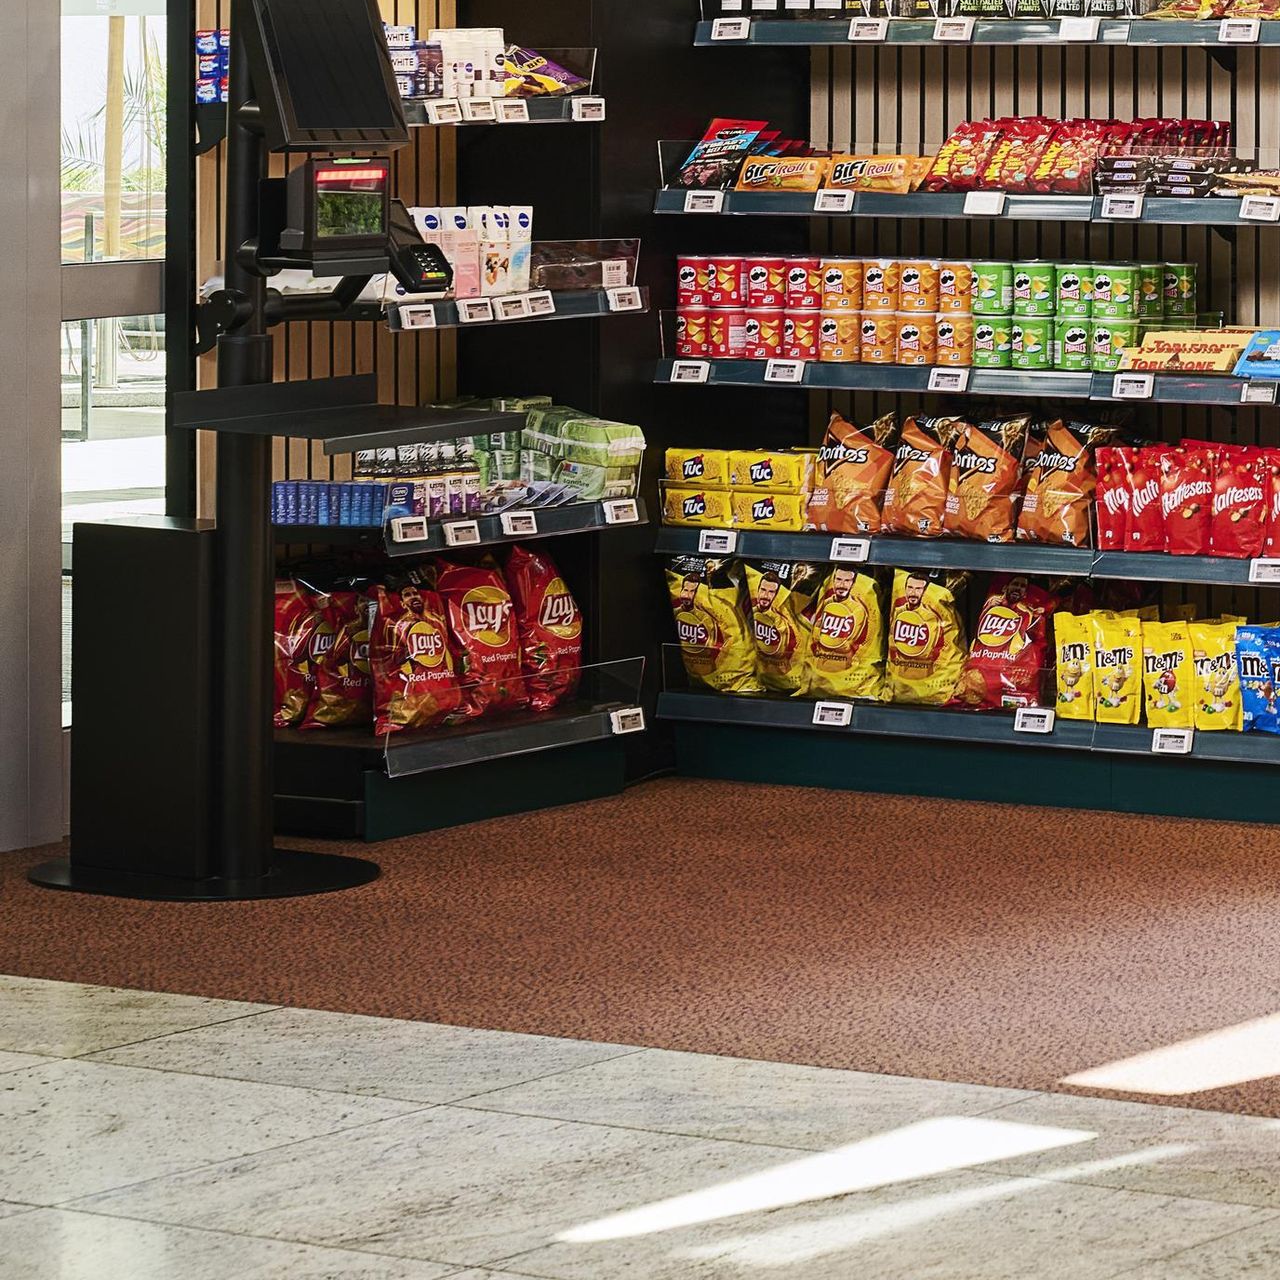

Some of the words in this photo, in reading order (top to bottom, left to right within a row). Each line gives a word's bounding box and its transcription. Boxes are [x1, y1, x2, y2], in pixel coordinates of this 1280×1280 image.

[386, 34, 409, 42] WHITE
[392, 58, 414, 66] WHITE
[526, 58, 545, 69] BIC
[867, 163, 894, 176] Roll
[1130, 358, 1216, 370] TOBLRONE
[818, 444, 868, 464] Doritos
[896, 444, 930, 461] ritos
[466, 600, 513, 633] Lay's
[821, 612, 852, 638] Lay's
[980, 614, 1019, 636] Lay's
[678, 620, 707, 644] Lay's
[754, 620, 780, 645] Lay's
[894, 621, 927, 646] Lay's
[411, 632, 442, 656] Lay's
[482, 654, 496, 664] Red
[982, 649, 1016, 660] Paprika
[408, 673, 426, 682] Red
